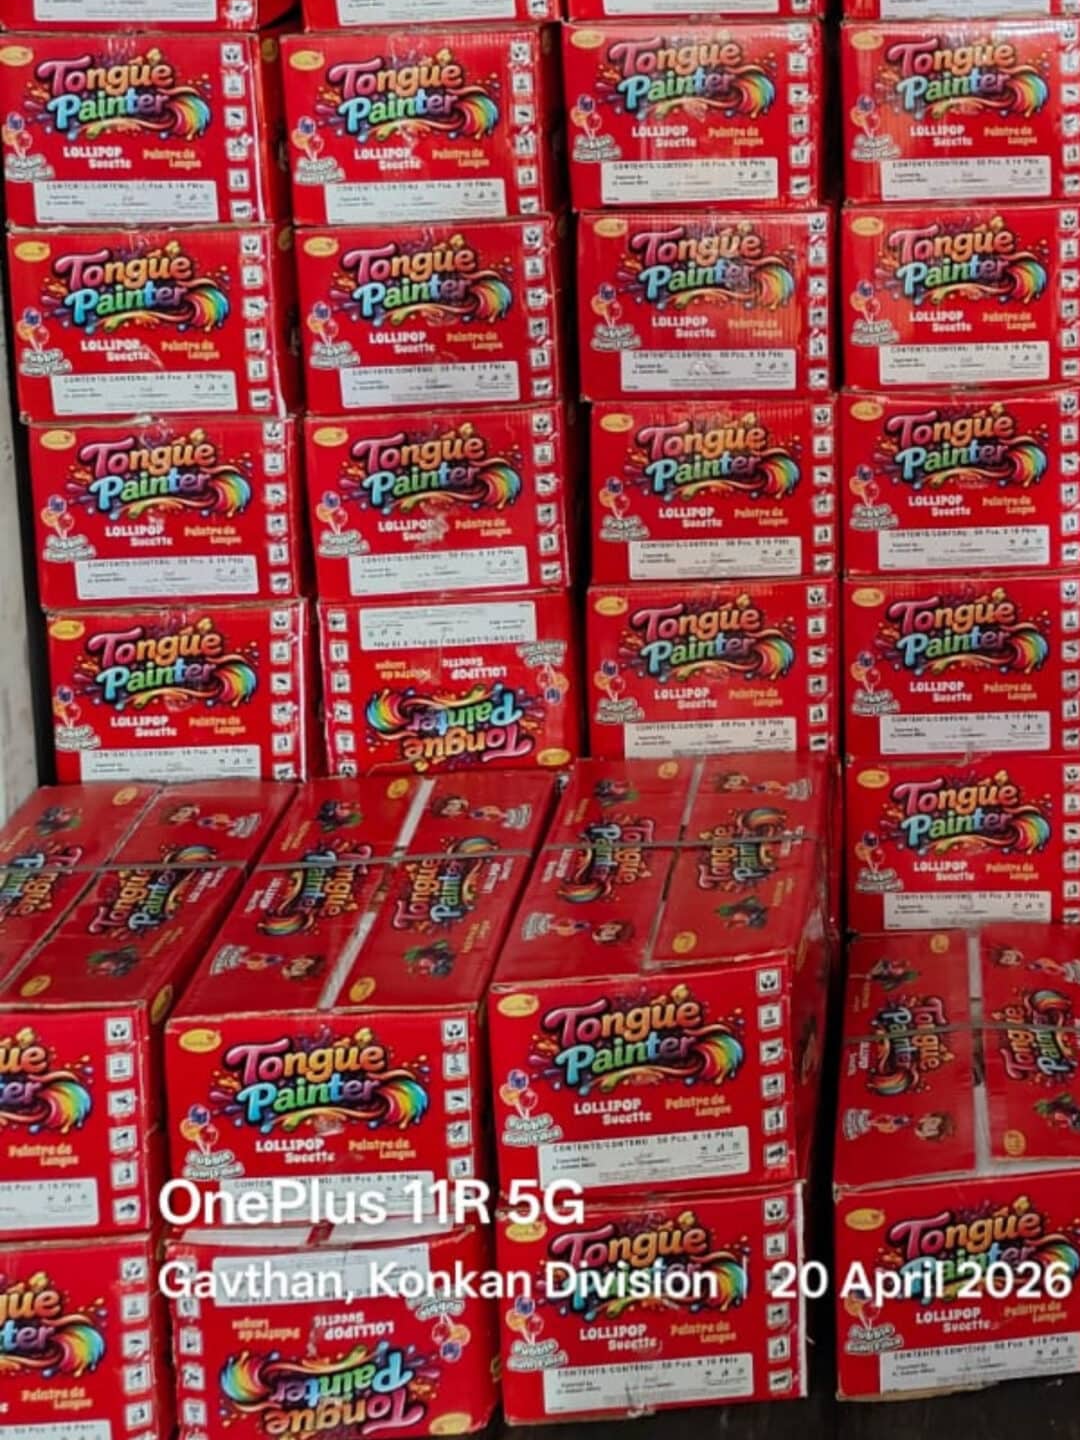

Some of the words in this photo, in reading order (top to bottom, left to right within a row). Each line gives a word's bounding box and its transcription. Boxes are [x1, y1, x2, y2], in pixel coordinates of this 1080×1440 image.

[37, 55, 172, 96] Tongue
[887, 37, 1013, 76] Tongue
[897, 67, 1010, 111] Painter
[48, 87, 169, 131] Painter
[63, 146, 123, 159] LOLLIPOP
[55, 250, 191, 289] Tongue
[343, 244, 475, 282] Tongue
[66, 281, 188, 325] Painter
[354, 273, 472, 318] Painter
[80, 338, 141, 352] LOLLIPOP
[637, 421, 765, 459] Tongue
[887, 409, 1013, 447] Tongue
[80, 438, 215, 476] Tongue
[646, 450, 761, 493] Painter
[896, 439, 1009, 481] Painter
[91, 467, 211, 511] Painter
[105, 524, 165, 538] LOLLIPOP
[658, 506, 716, 519] LOLLIPOP
[889, 596, 1015, 633] Tongue
[897, 625, 1011, 667] Painter
[909, 680, 966, 694] LOLLIPOP
[893, 778, 1017, 815] Tongue
[901, 807, 1013, 847] Painter
[913, 860, 969, 873] LOLLIPOP
[545, 998, 701, 1044] Tongue
[226, 1039, 384, 1083] Tongue
[557, 1031, 696, 1086] Painter
[238, 1073, 380, 1123] Painter
[573, 1097, 643, 1117] LOLLIPOP
[255, 1137, 326, 1154] LOLLIPOP
[552, 1225, 707, 1269] Tongue
[890, 1209, 1041, 1256] Tongue
[323, 1319, 395, 1341] LOLLIPOP
[579, 1323, 649, 1342] LOLLIPOP
[915, 1305, 983, 1326] LOLLIPOP
[268, 1350, 411, 1406] Painter
[264, 1391, 424, 1440] Tongue
